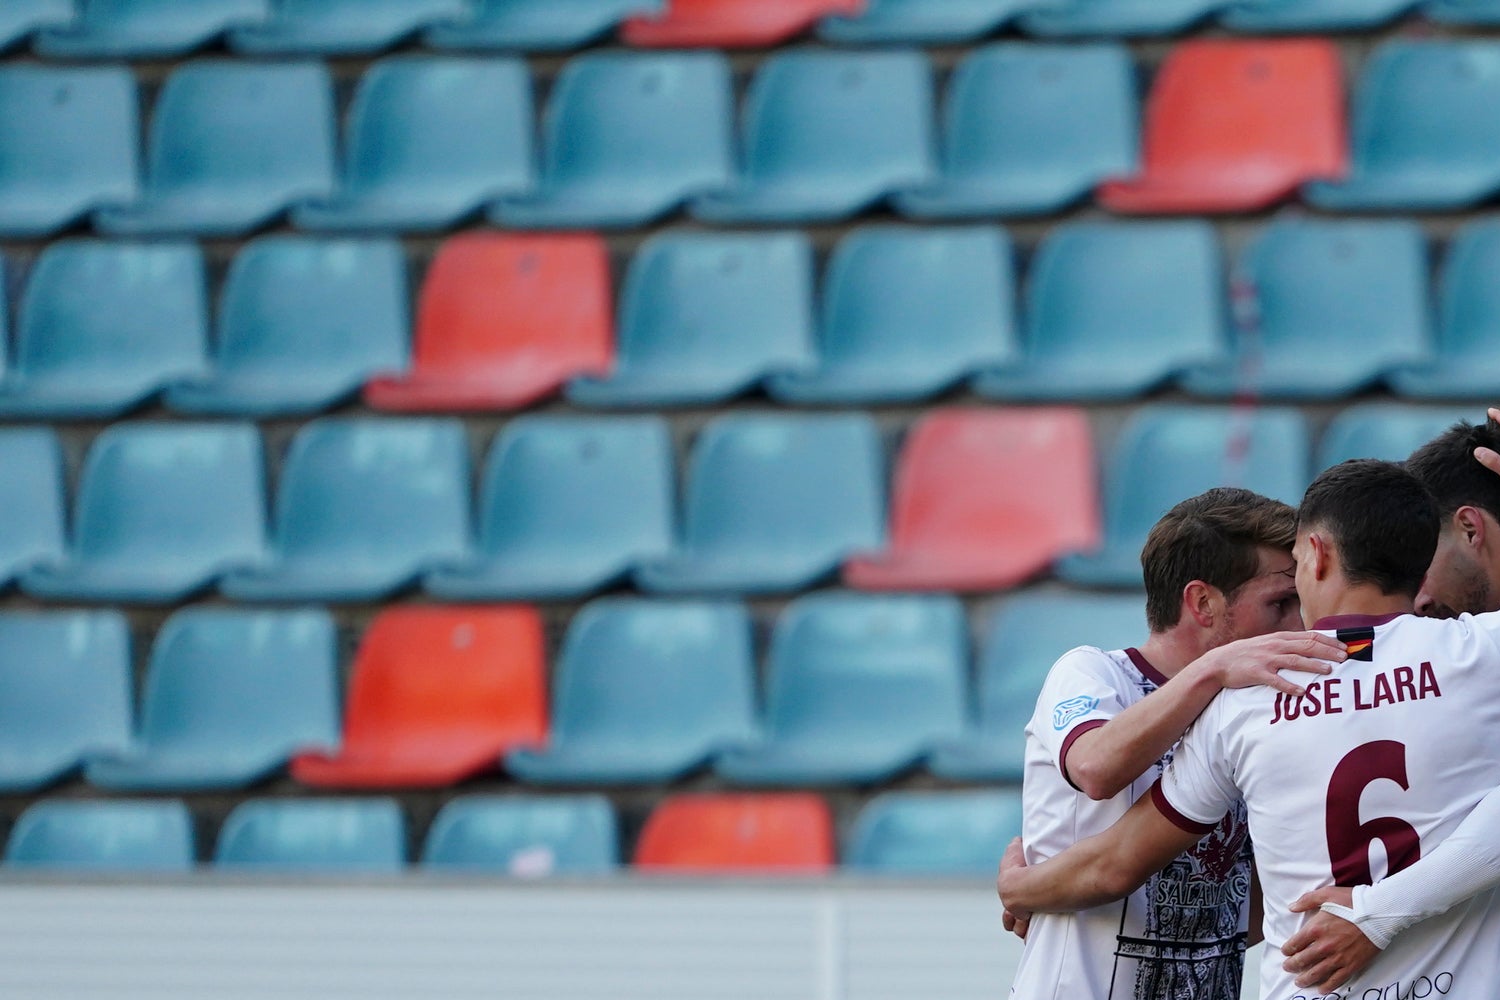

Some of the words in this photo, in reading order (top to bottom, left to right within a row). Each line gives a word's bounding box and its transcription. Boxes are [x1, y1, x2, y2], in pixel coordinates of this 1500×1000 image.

[1270, 678, 1343, 725] JOSE
[1353, 660, 1442, 711] LARA
[1325, 739, 1420, 887] 6
